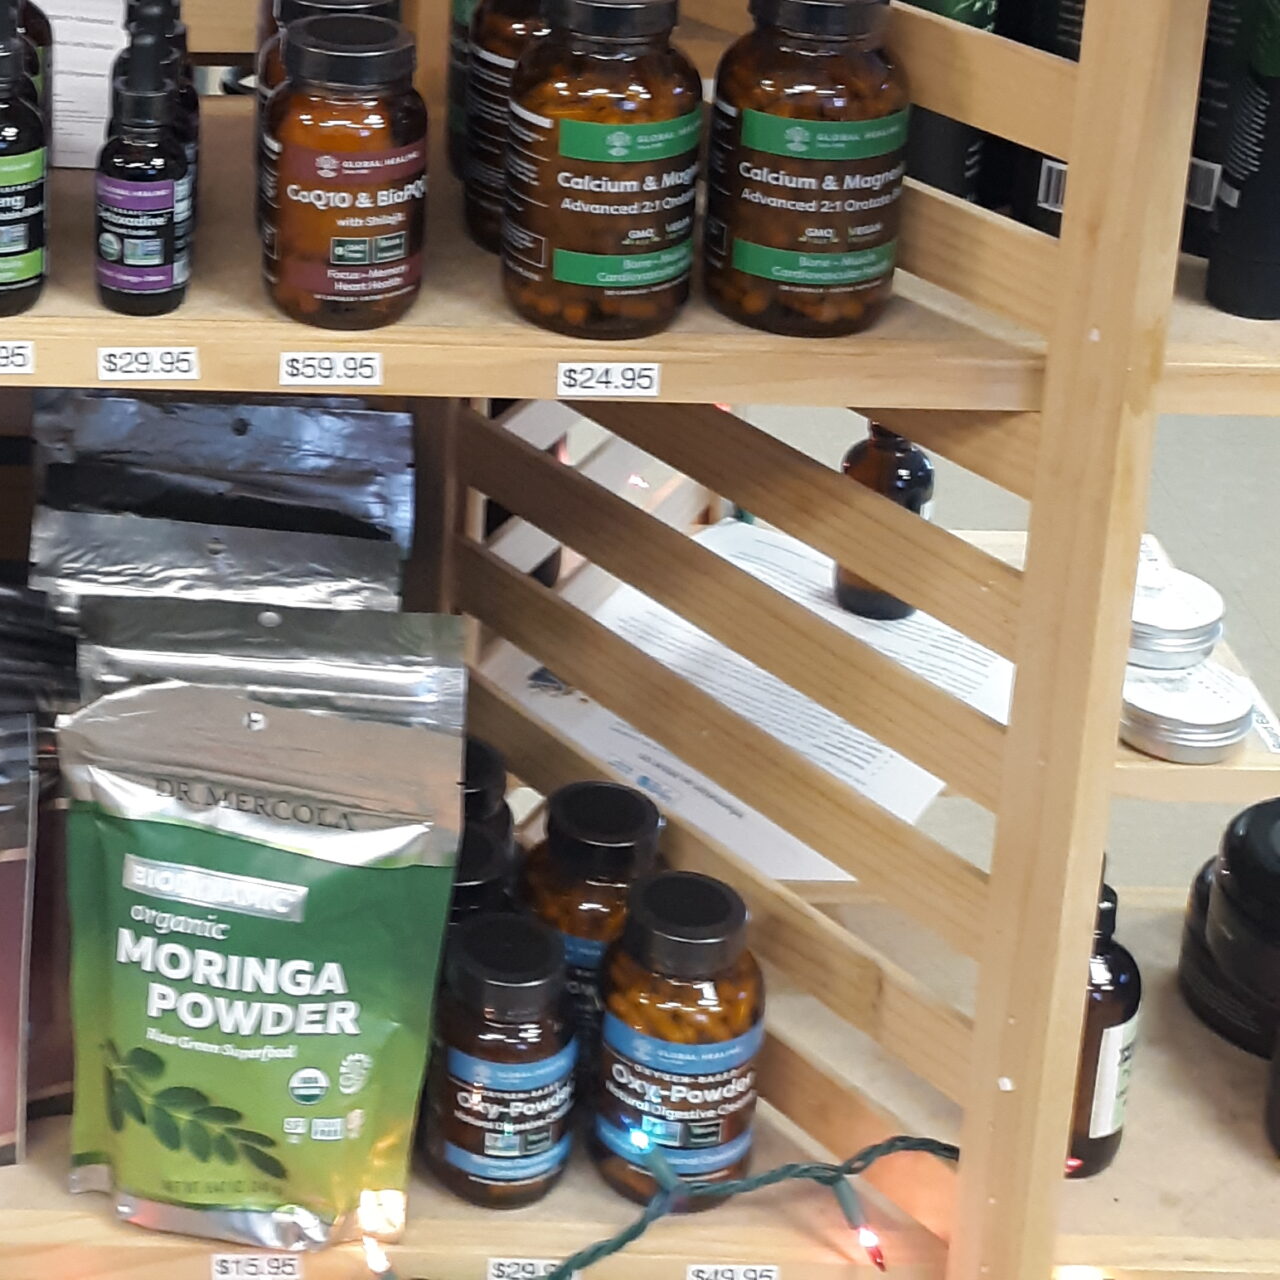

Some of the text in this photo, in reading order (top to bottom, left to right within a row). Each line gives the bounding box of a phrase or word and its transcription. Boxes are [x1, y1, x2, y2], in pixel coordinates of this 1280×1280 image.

[557, 172, 640, 193] Calcium
[642, 175, 658, 191] &
[739, 161, 817, 190] Calcium
[821, 175, 840, 190] &
[287, 184, 353, 210] CoQ10
[355, 192, 375, 208] &
[561, 197, 639, 214] Advanced
[741, 188, 816, 212] Advanced
[820, 199, 842, 212] 2:1
[102, 351, 195, 374] $29.95
[285, 356, 378, 380] $59.95
[562, 367, 655, 391] $24.95
[206, 785, 355, 831] MERCOLA
[130, 904, 231, 940] organic
[116, 928, 350, 996] MORINGA
[146, 982, 361, 1037] POWDER
[221, 1041, 297, 1063] Superfood
[611, 1063, 757, 1104] Oxy-Powder
[215, 1257, 297, 1276] $15.95
